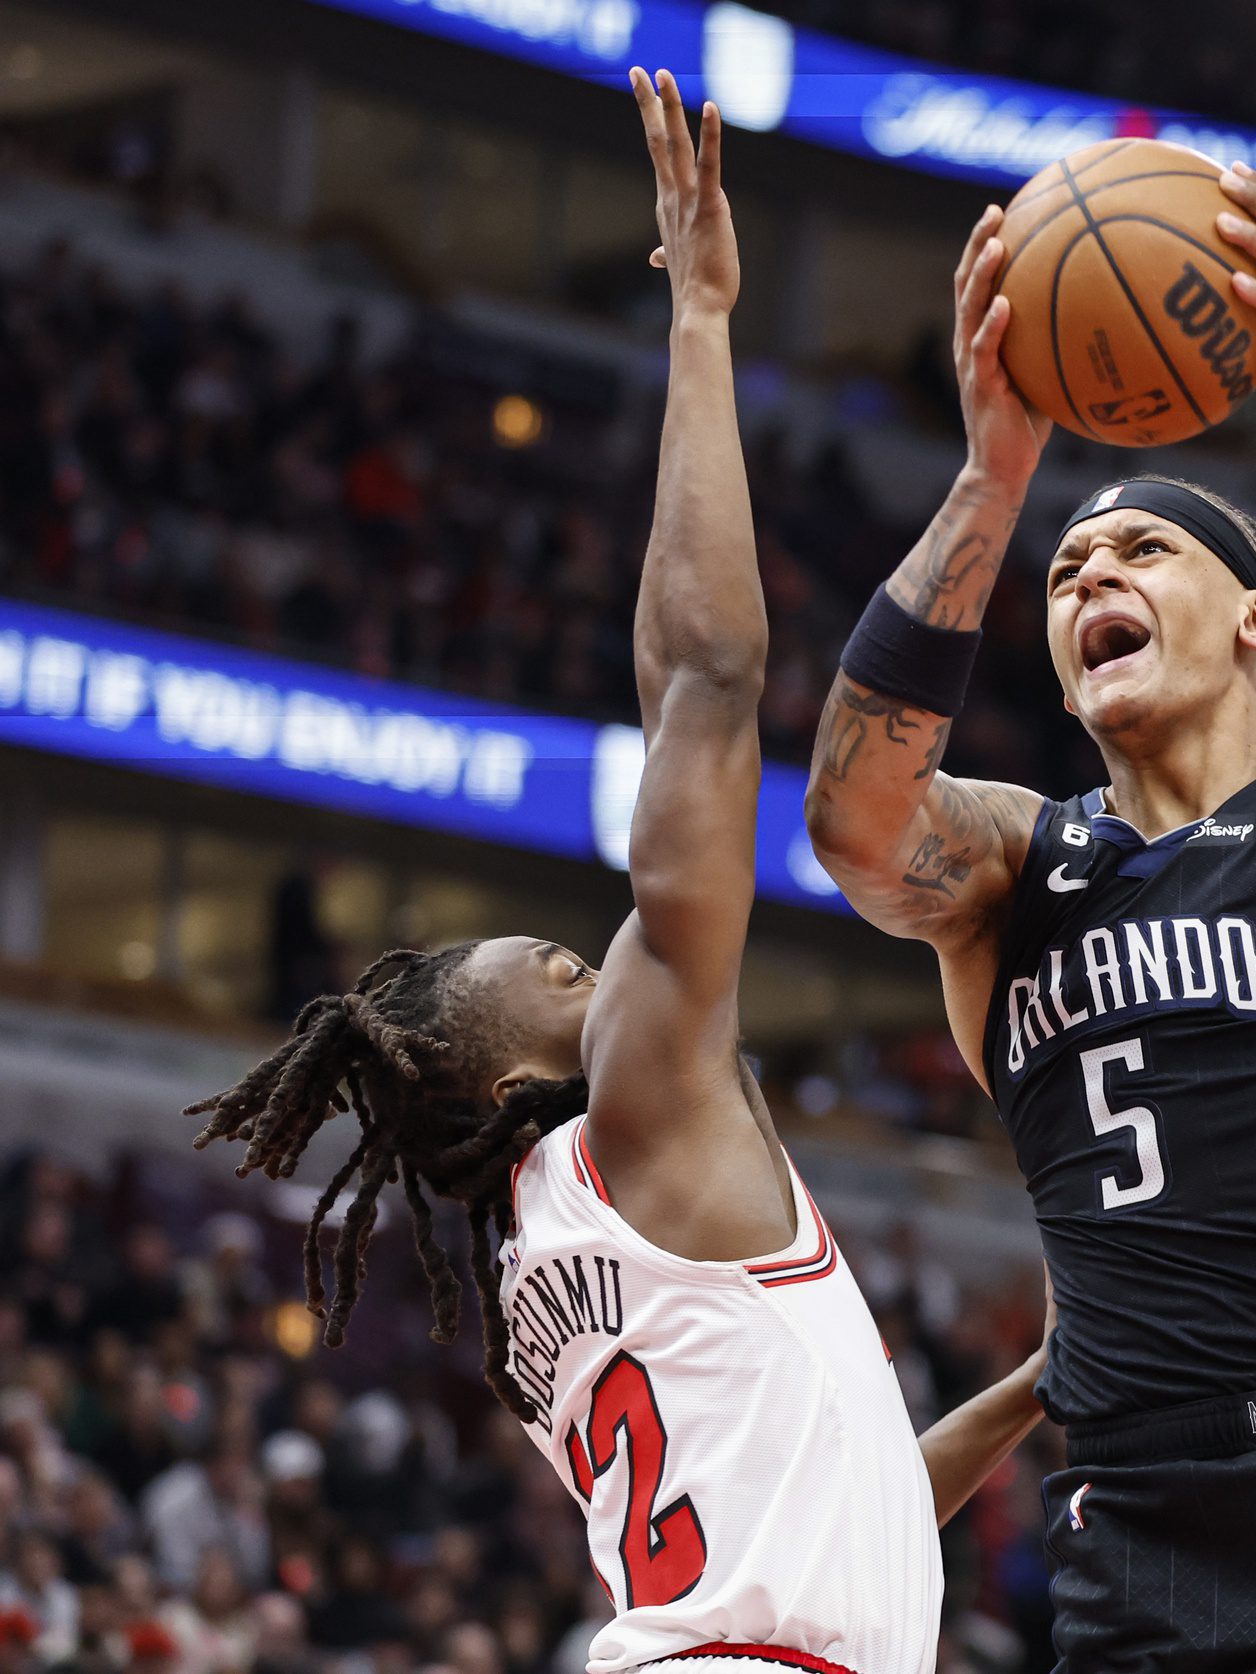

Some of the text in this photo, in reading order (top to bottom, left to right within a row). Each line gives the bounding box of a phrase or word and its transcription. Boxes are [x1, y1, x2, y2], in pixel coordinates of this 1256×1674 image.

[1163, 261, 1255, 403] Wilso
[1061, 822, 1091, 847] 6
[1079, 1037, 1165, 1211] 5
